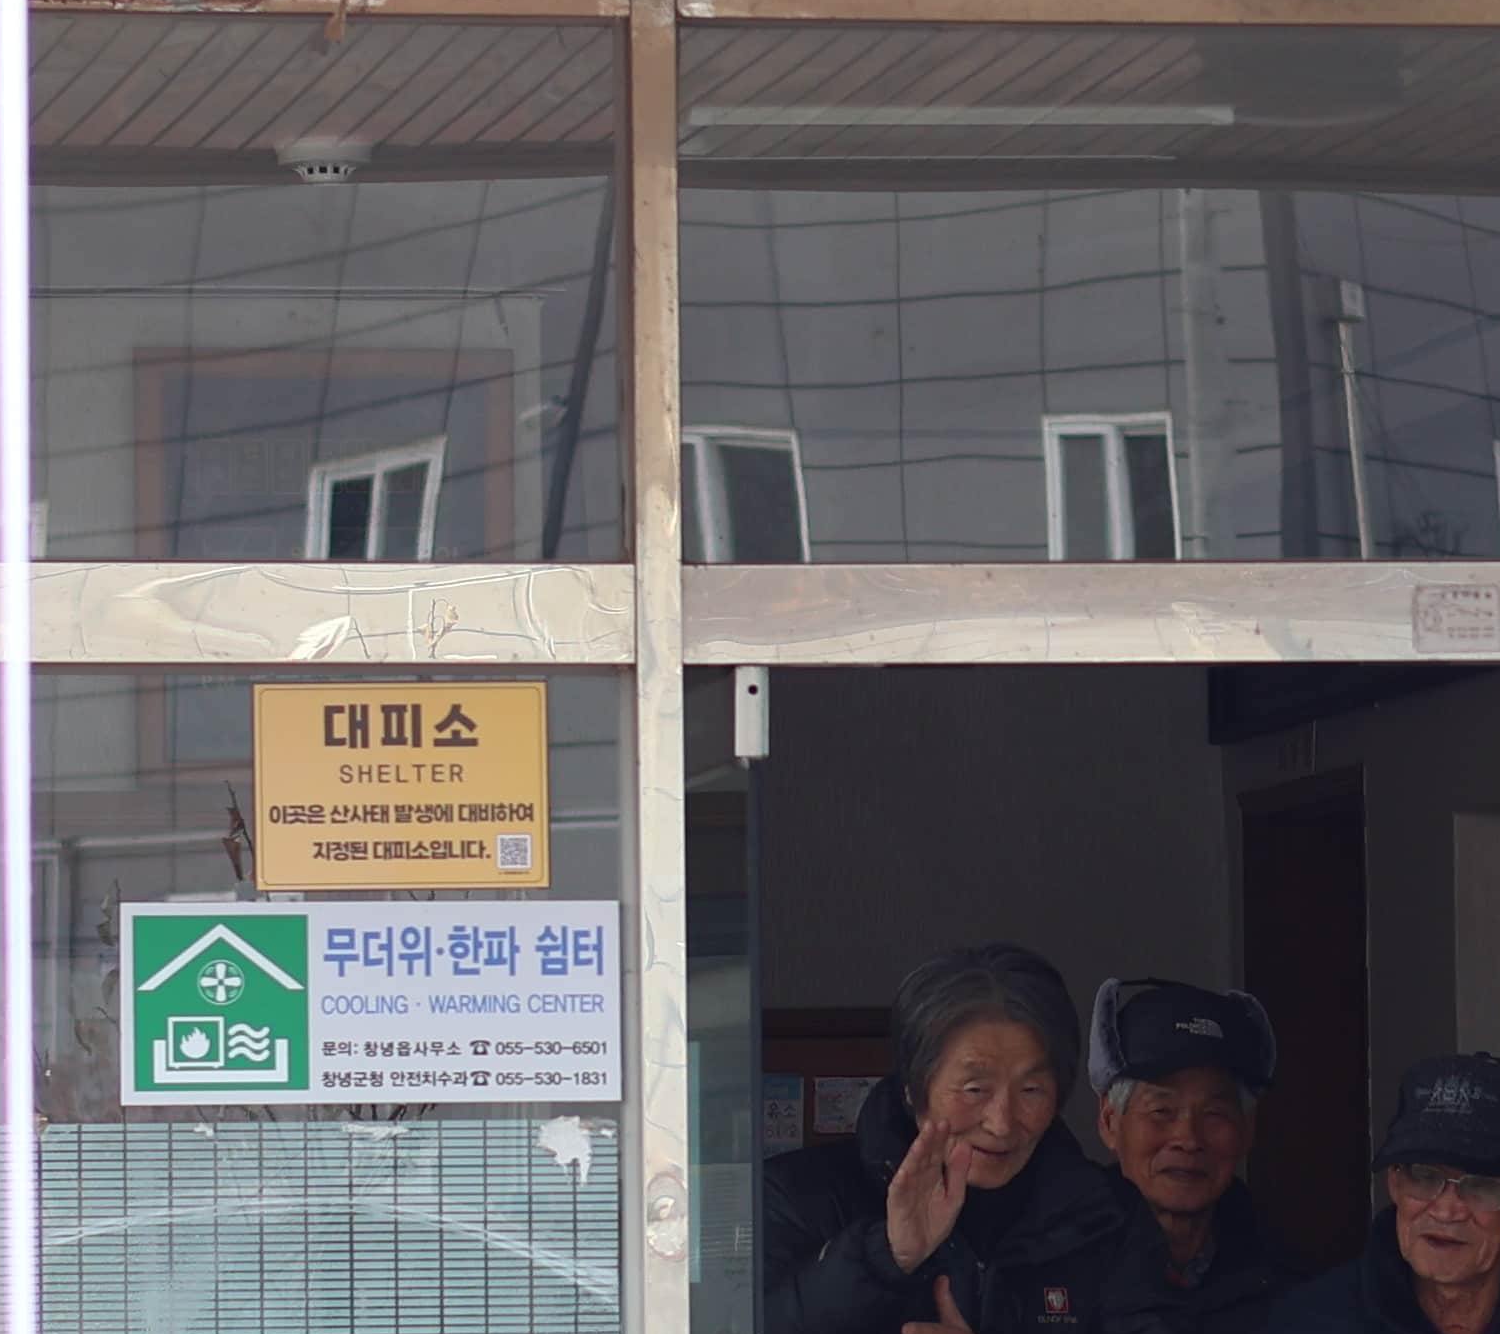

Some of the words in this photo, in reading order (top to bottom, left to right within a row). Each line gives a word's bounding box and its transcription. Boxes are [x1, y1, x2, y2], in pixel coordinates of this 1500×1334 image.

[323, 703, 479, 749] 대피소
[339, 763, 465, 784] SHELTER
[269, 804, 326, 824] 이곳은
[330, 803, 390, 824] 산사태
[394, 803, 454, 824] 발생에
[458, 802, 534, 823] 대비하여
[312, 840, 368, 861] 지정된
[373, 839, 491, 860] 대피소입니다.
[323, 925, 520, 977] 무더위·한파
[535, 925, 603, 977] 쉼터
[321, 994, 409, 1015] COOLING
[428, 994, 520, 1015] WARMING
[527, 993, 604, 1014] CENTER
[321, 1041, 358, 1057] 문의:
[363, 1040, 461, 1057] 창녕읍사무소
[495, 1041, 607, 1056] 055-530-6501
[321, 1071, 383, 1088] 창녕군청
[389, 1071, 468, 1087] 안전치수과
[495, 1071, 607, 1086] 055-530-1831
